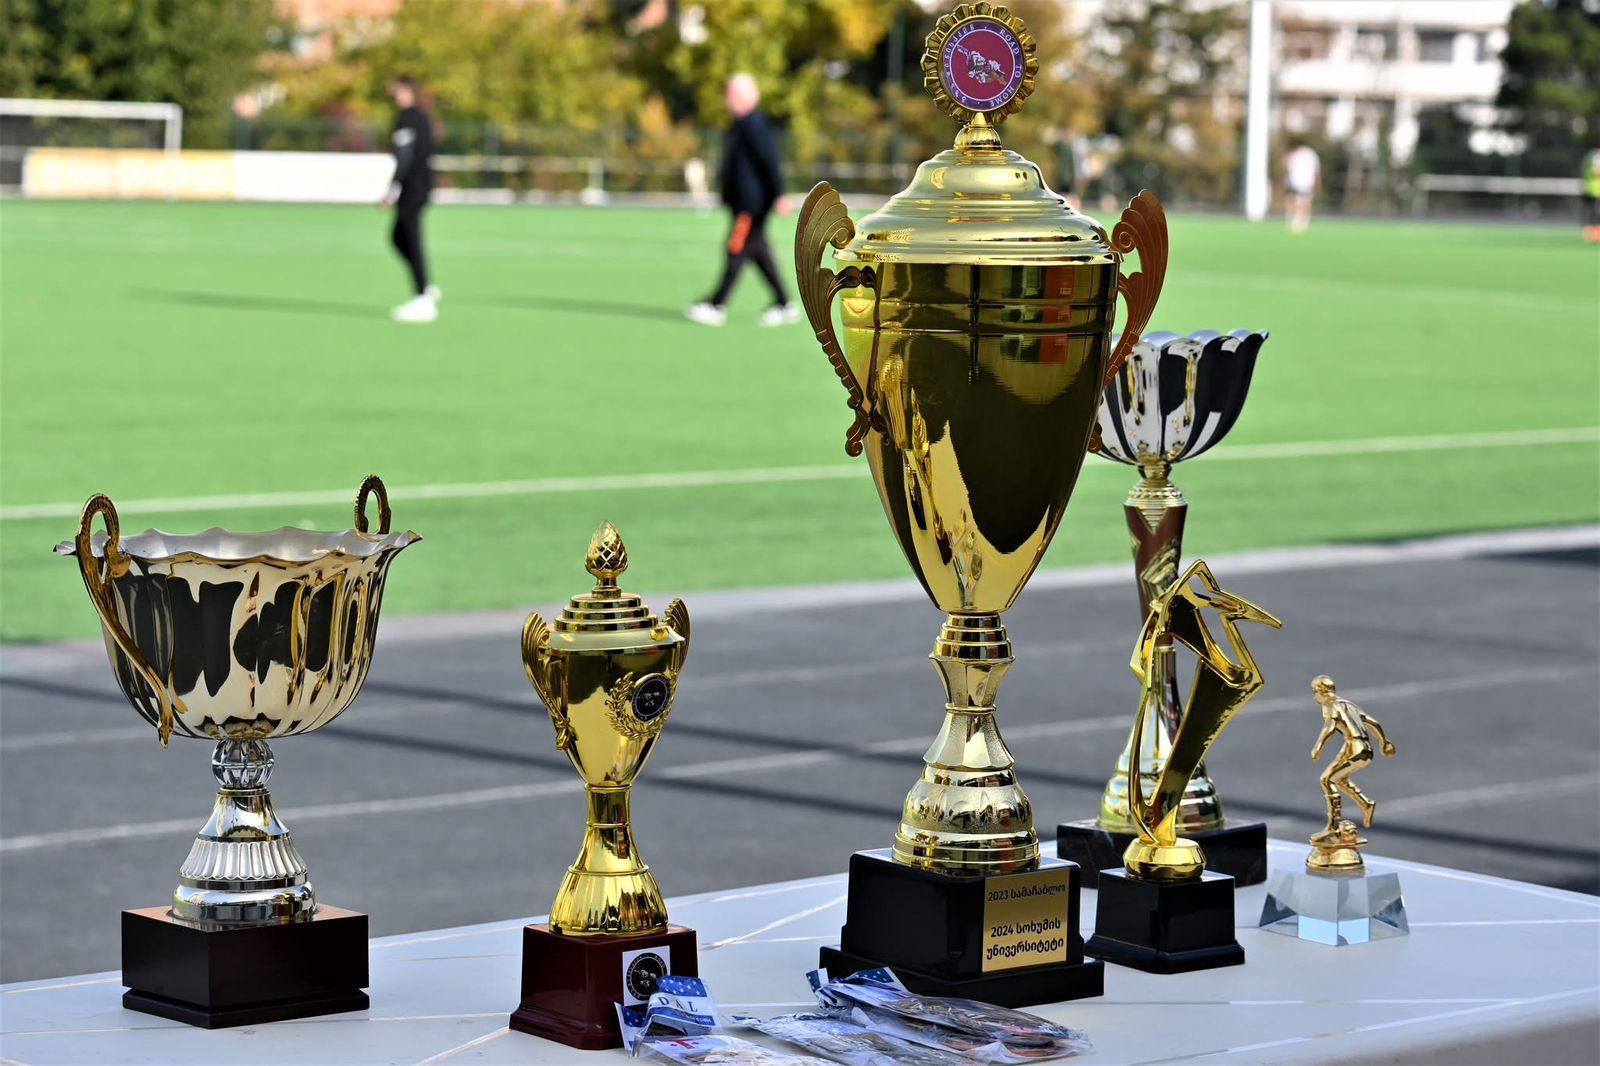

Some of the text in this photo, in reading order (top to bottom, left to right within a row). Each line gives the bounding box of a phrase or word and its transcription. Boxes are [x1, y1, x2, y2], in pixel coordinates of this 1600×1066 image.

[989, 28, 1023, 107] ROAD TO HOME
[988, 884, 1066, 901] 2023 სამაჩაბლო
[990, 917, 1061, 938] 2024 სოხუმის
[986, 938, 1064, 960] უნივერსიტეტი
[649, 996, 698, 1013] DAL
